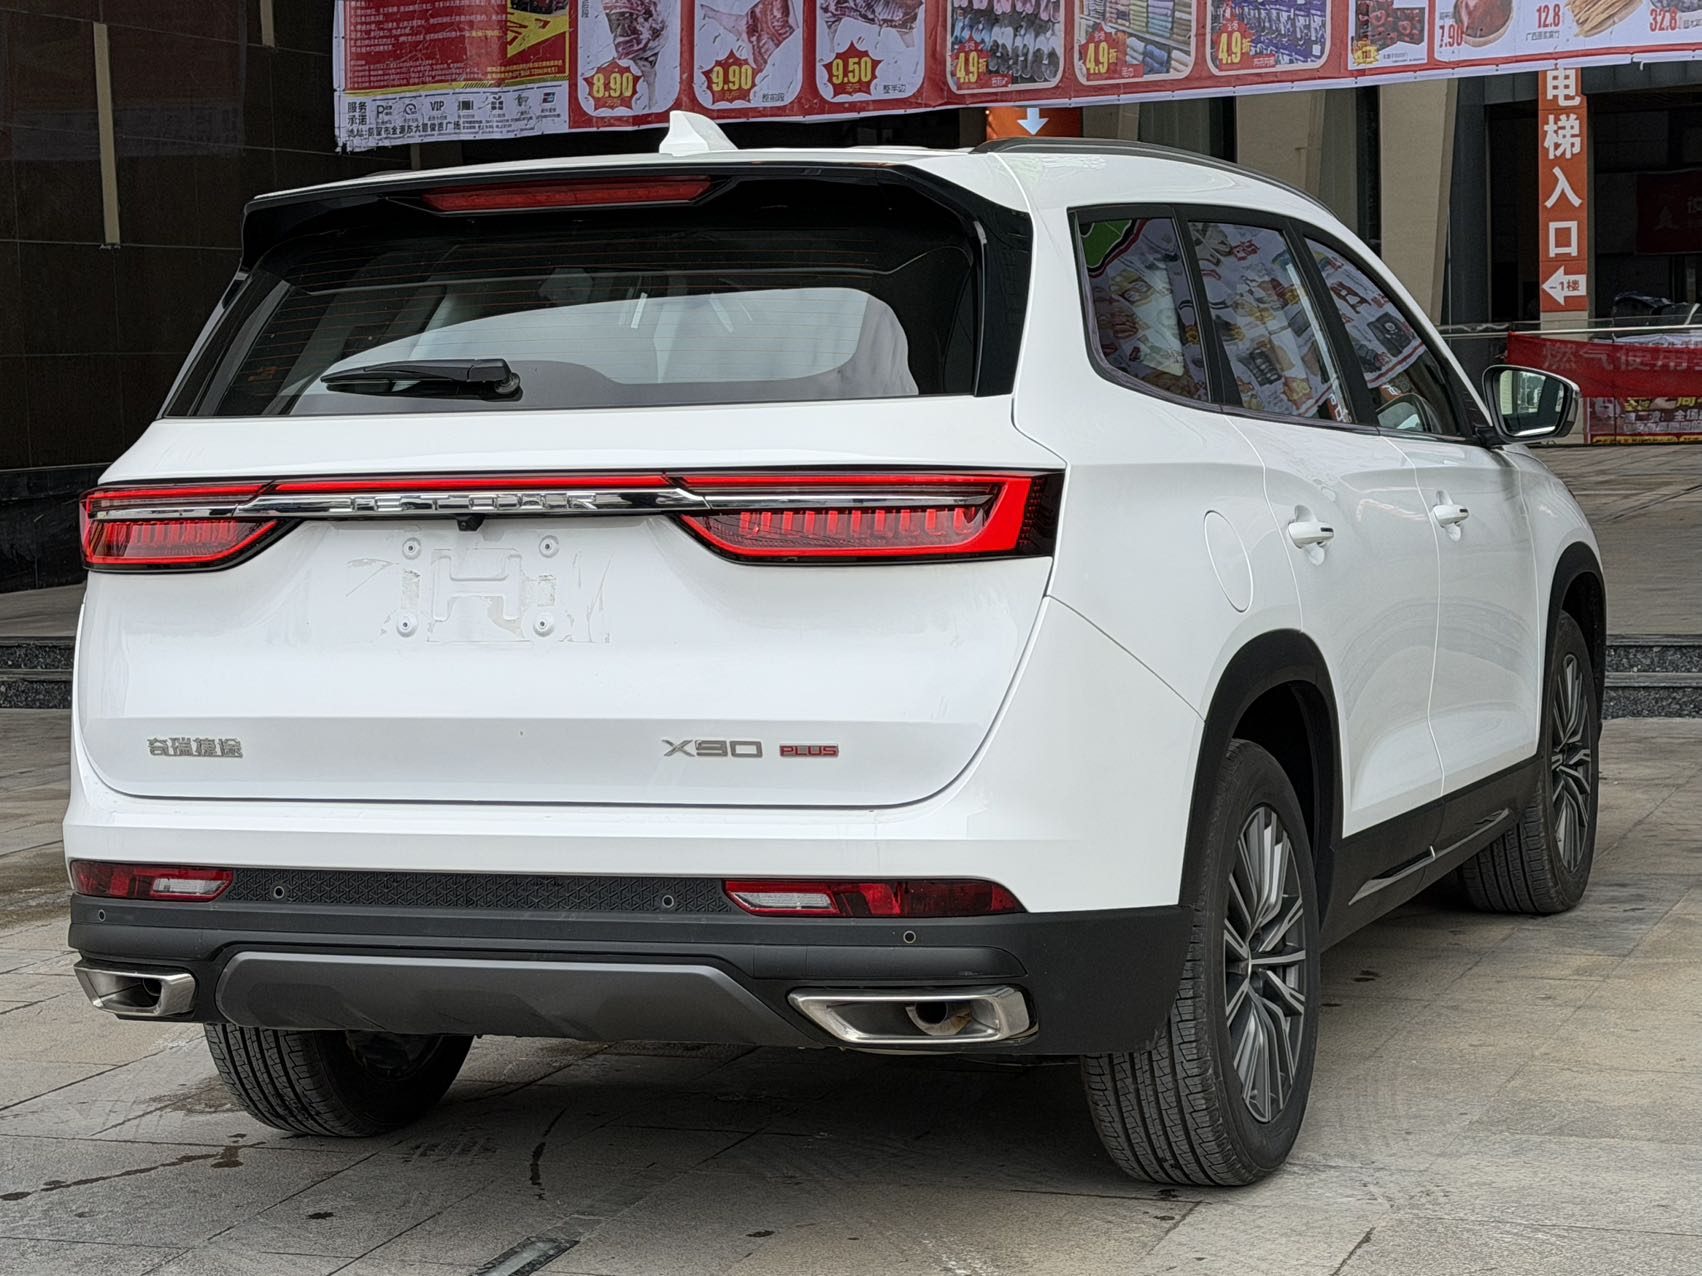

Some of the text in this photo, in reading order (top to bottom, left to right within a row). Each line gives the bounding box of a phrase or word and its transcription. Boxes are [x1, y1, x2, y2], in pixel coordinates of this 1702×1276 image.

[1536, 3, 1561, 28] 12.8
[1650, 6, 1678, 32] 32.8
[1438, 23, 1464, 48] 7.90
[711, 64, 753, 91] 9.90
[832, 56, 873, 84] 9.50
[592, 72, 634, 98] 8.90
[347, 101, 368, 114] 服务
[430, 100, 446, 111] VIP
[347, 114, 368, 126] 承诺
[1543, 66, 1583, 258] 电梯入口
[660, 739, 839, 758] X90 PLUS
